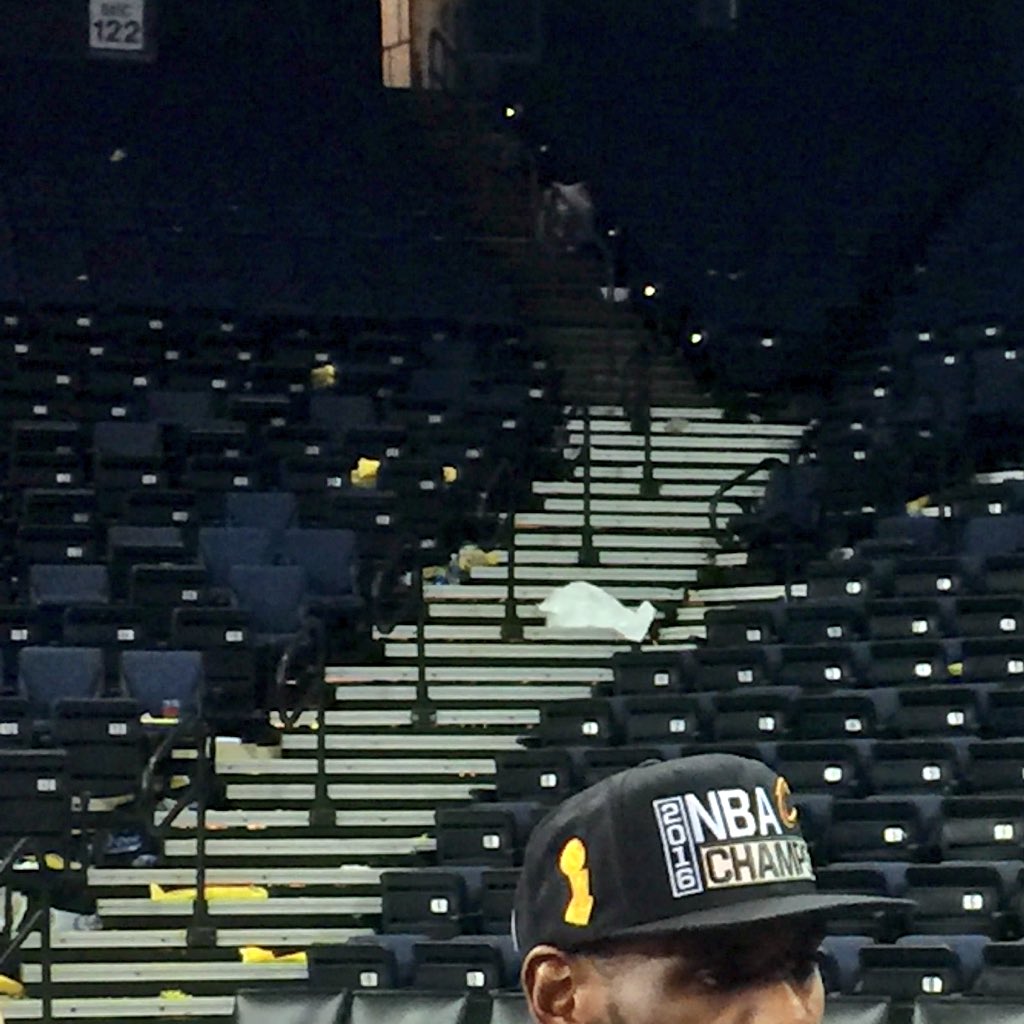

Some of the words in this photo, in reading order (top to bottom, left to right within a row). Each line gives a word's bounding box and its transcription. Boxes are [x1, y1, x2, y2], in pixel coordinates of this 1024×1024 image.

[94, 20, 140, 43] 122
[684, 786, 783, 843] NBA
[660, 803, 697, 890] 2016
